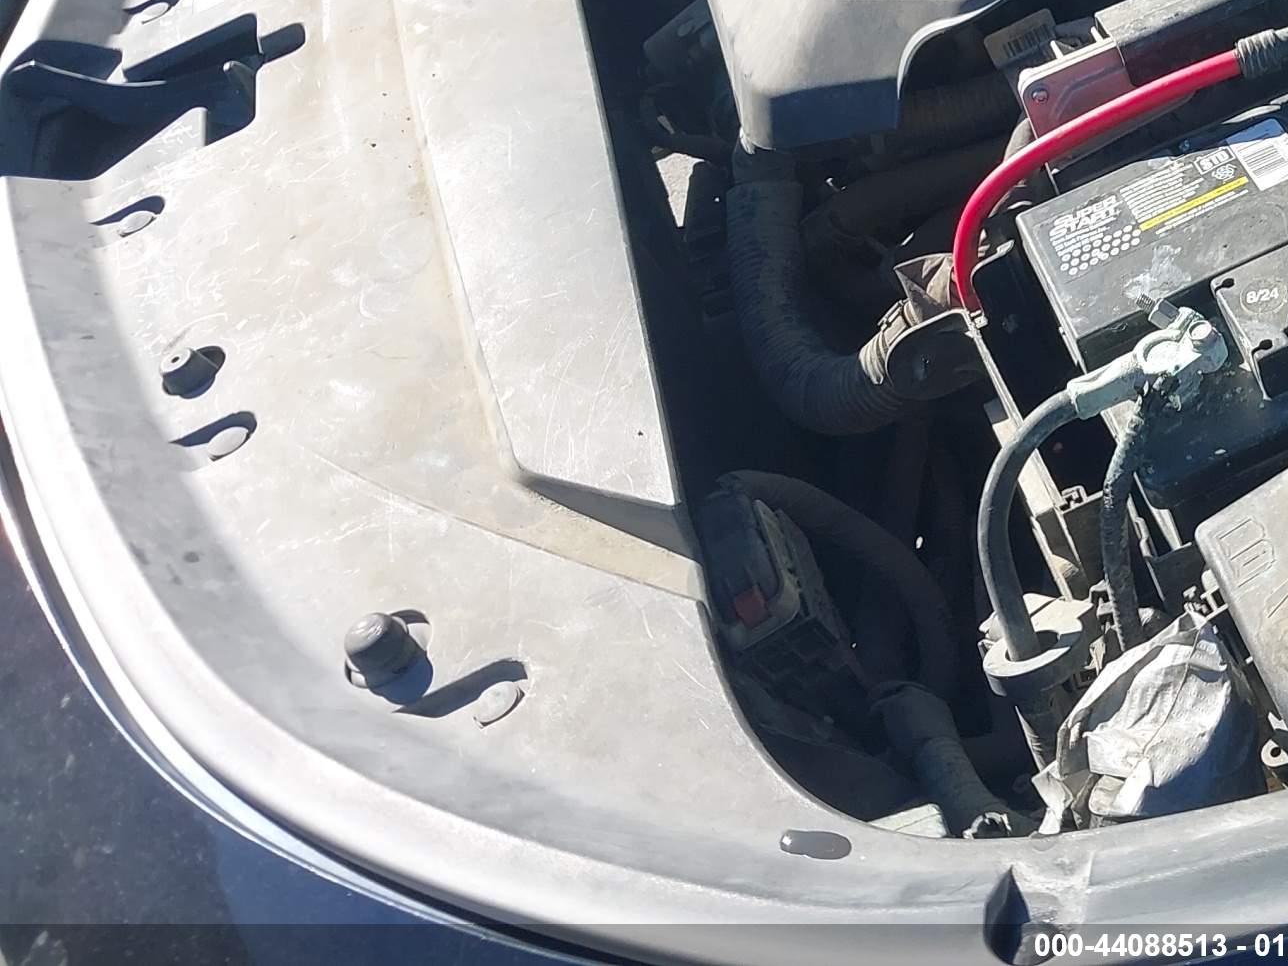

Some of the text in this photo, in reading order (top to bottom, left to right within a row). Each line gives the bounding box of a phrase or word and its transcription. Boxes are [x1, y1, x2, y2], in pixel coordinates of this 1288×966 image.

[1200, 150, 1229, 171] STD
[1050, 200, 1123, 239] START
[1053, 193, 1117, 226] SUPER
[1246, 286, 1279, 303] 8/24
